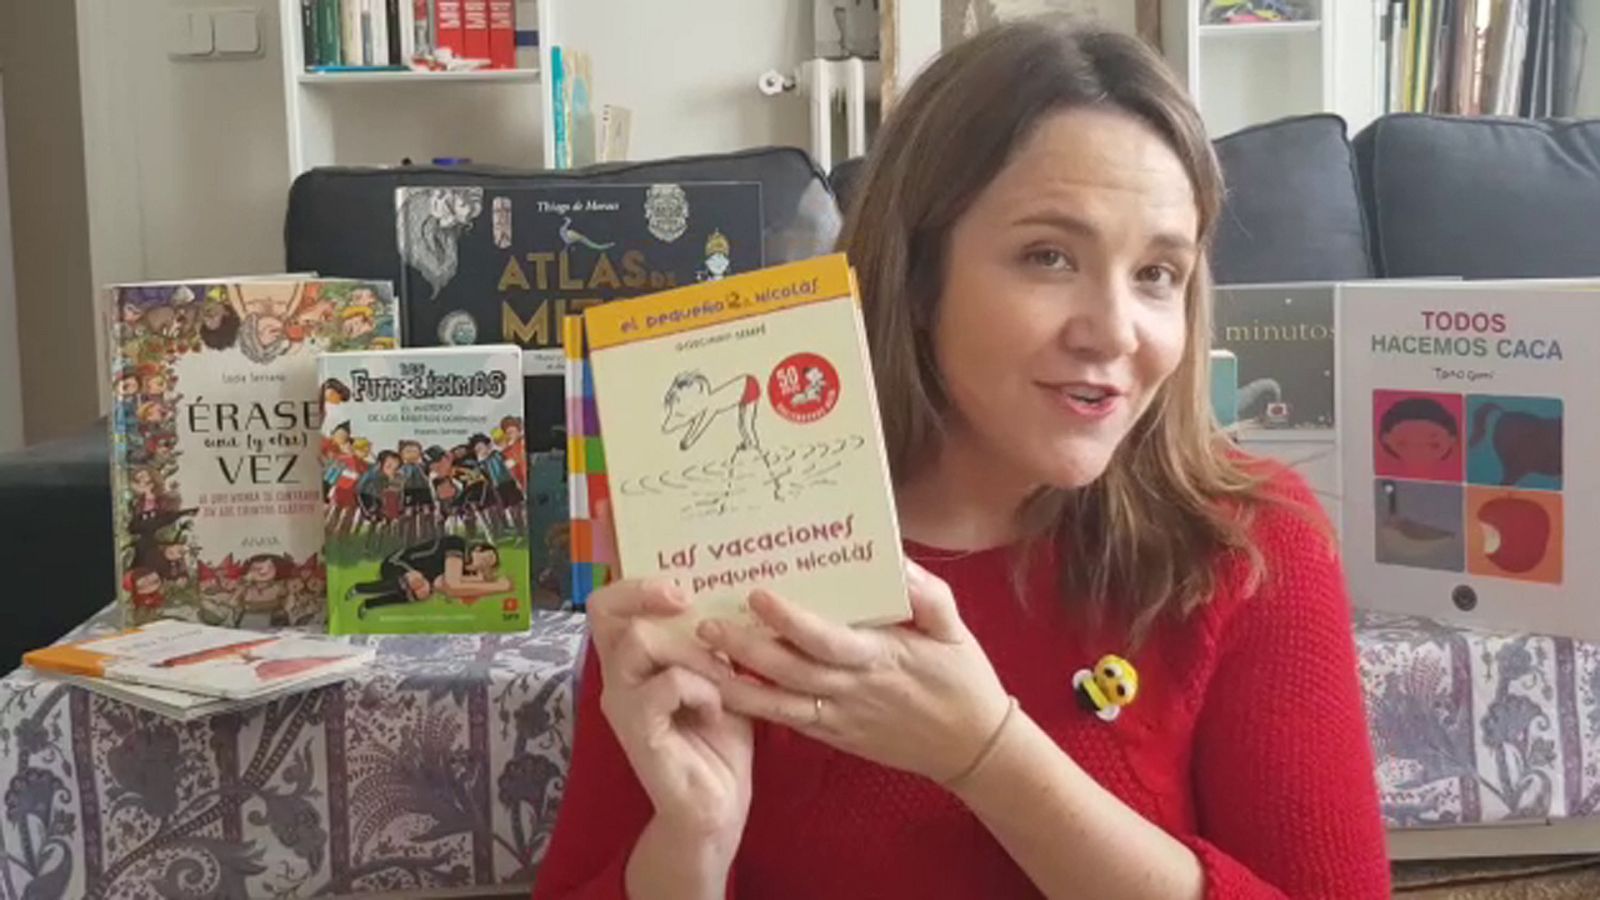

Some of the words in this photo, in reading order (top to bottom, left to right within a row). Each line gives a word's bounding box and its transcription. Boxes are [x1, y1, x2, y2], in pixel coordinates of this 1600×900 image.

[497, 249, 647, 291] ATLAS
[620, 318, 639, 333] el
[1421, 311, 1507, 334] TODOS
[1371, 334, 1489, 357] HACEMOS
[1496, 338, 1563, 361] CACA
[776, 364, 799, 388] 50
[186, 395, 321, 433] ÉRASE
[216, 454, 301, 485] VEZ
[657, 544, 697, 570] Las
